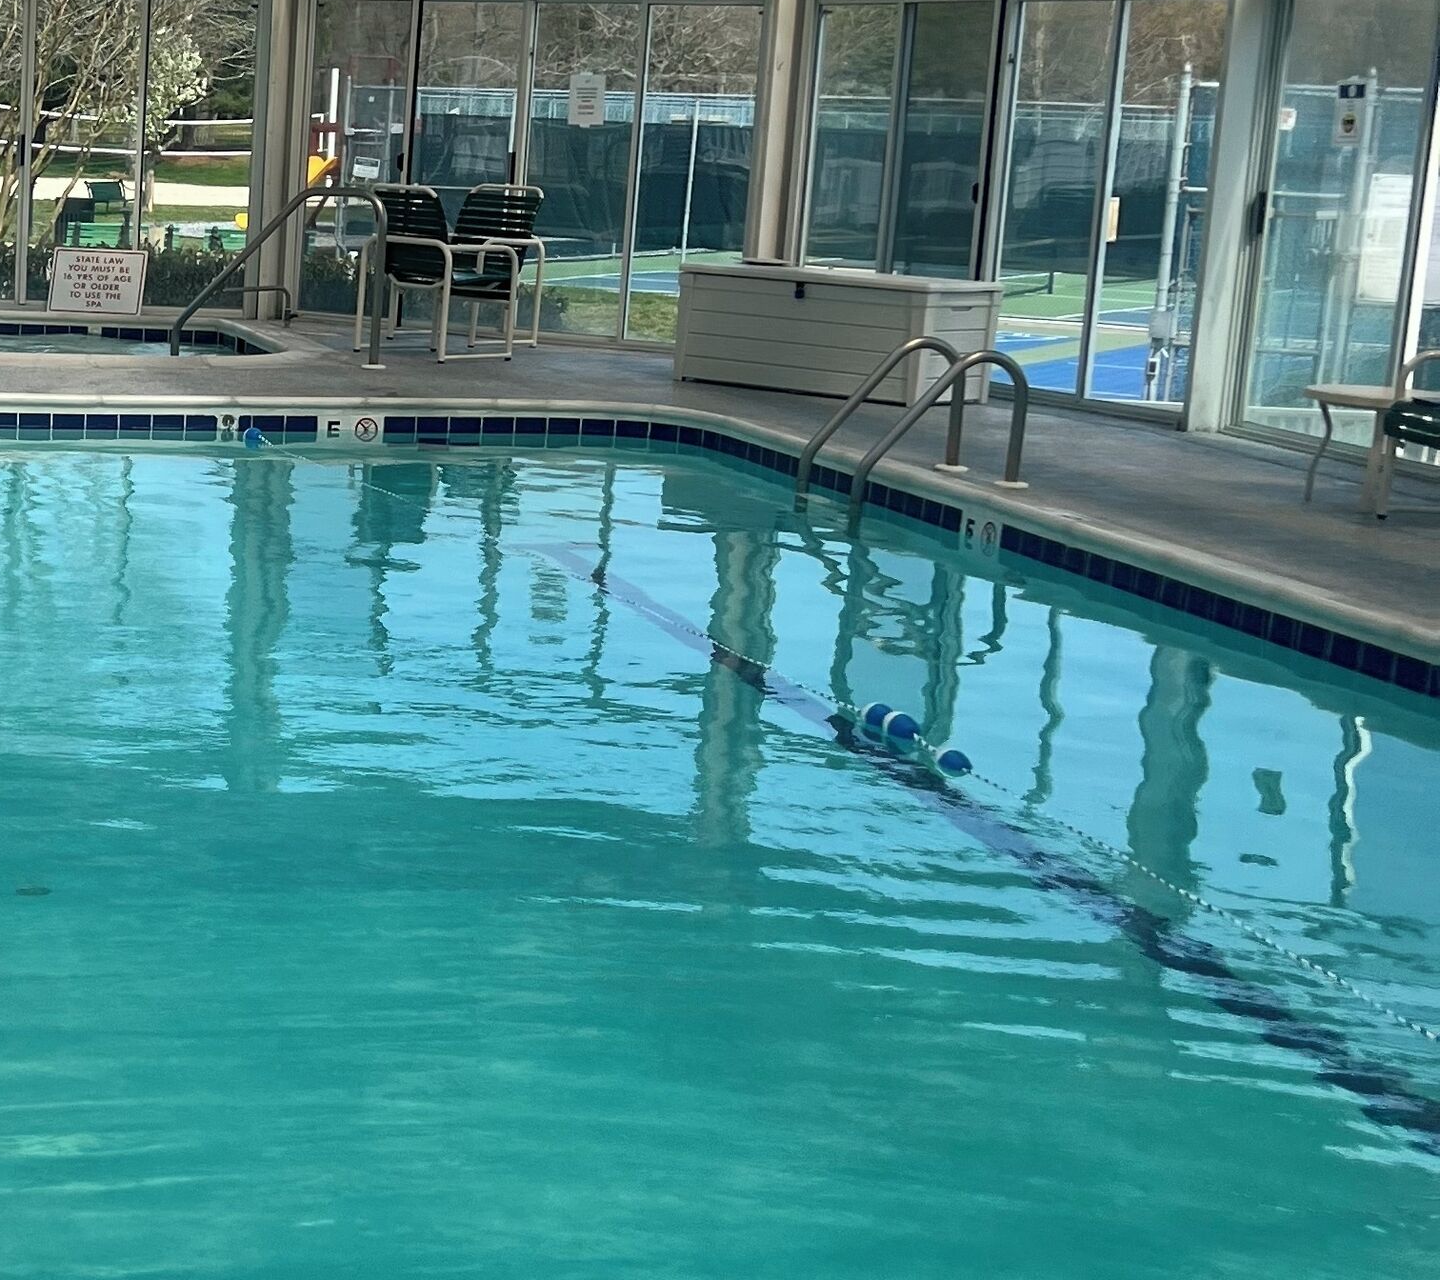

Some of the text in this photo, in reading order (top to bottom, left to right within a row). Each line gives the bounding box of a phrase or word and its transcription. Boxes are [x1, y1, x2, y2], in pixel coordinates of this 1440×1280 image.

[68, 264, 87, 272] YOU
[91, 265, 115, 273] MUST
[91, 283, 120, 291] OLDER
[105, 292, 121, 300] THE
